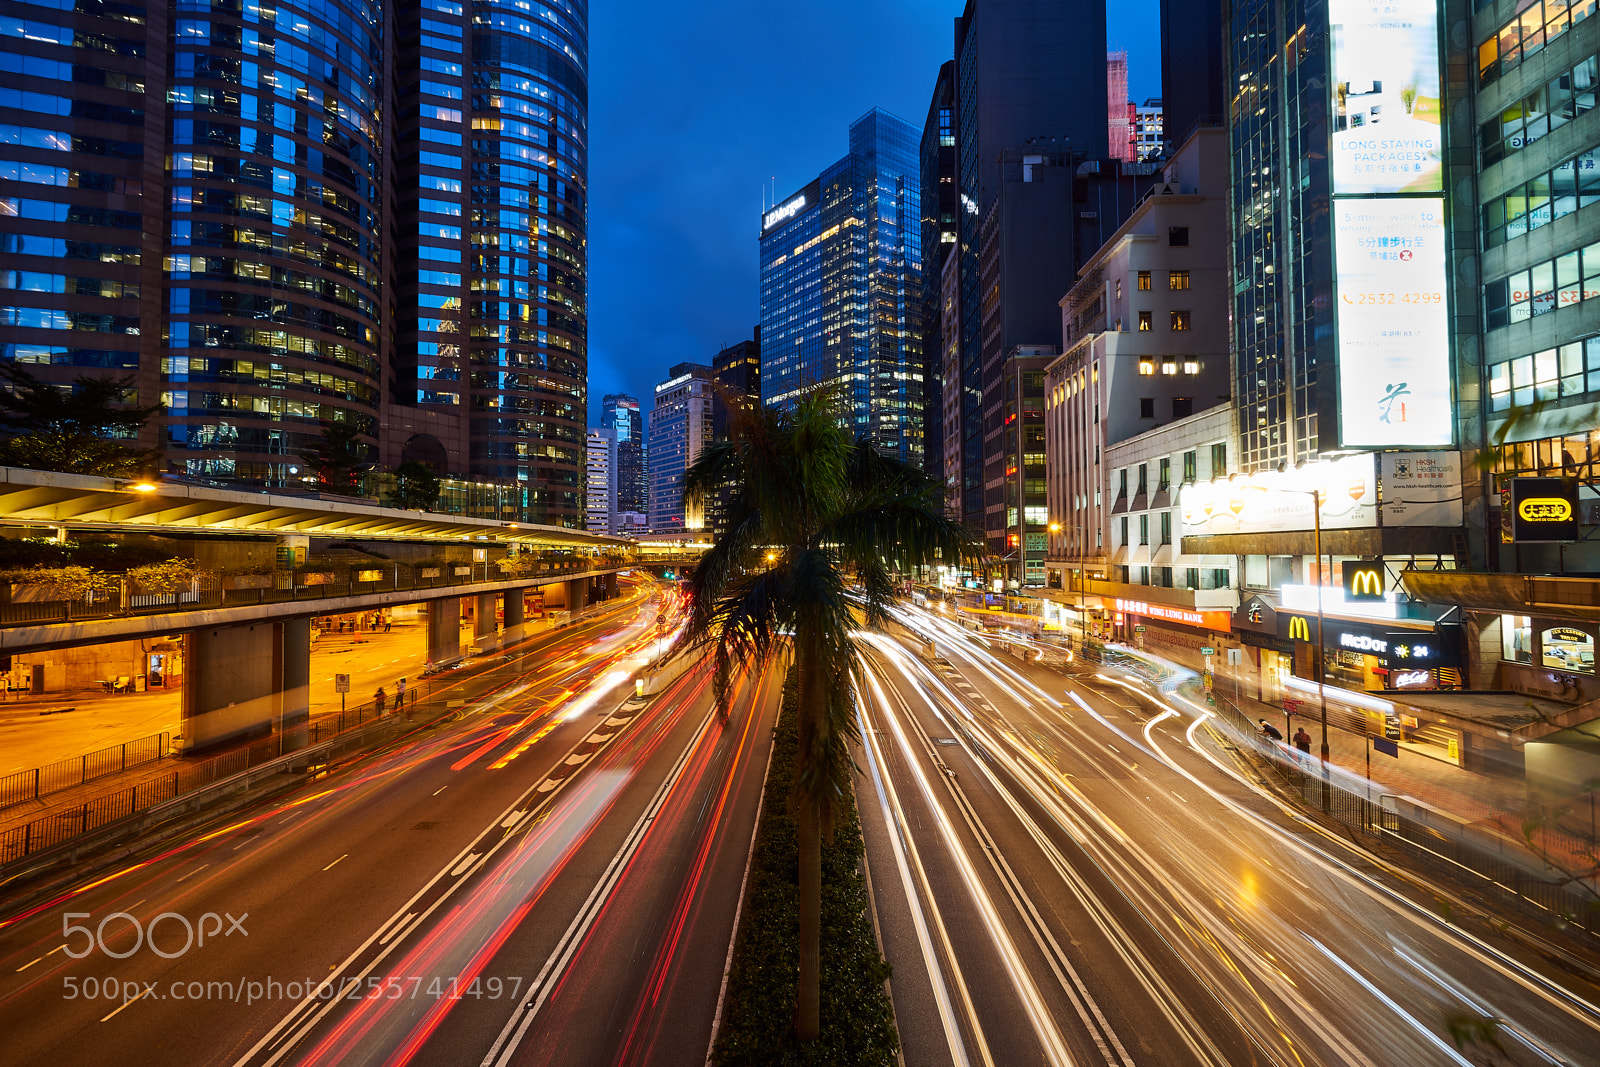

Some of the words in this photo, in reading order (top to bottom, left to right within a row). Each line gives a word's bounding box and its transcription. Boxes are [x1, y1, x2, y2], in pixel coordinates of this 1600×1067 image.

[1341, 140, 1377, 150] LONG
[1381, 139, 1433, 149] STAYING
[1354, 152, 1422, 162] PACKAGES
[1421, 212, 1434, 222] to
[1358, 293, 1395, 305] 2532
[1402, 292, 1441, 304] 4299
[1416, 465, 1454, 473] Healthcare
[1149, 606, 1164, 616] WING
[1165, 609, 1182, 619] LUNG
[1184, 612, 1204, 624] BANK
[1413, 645, 1429, 657] 24
